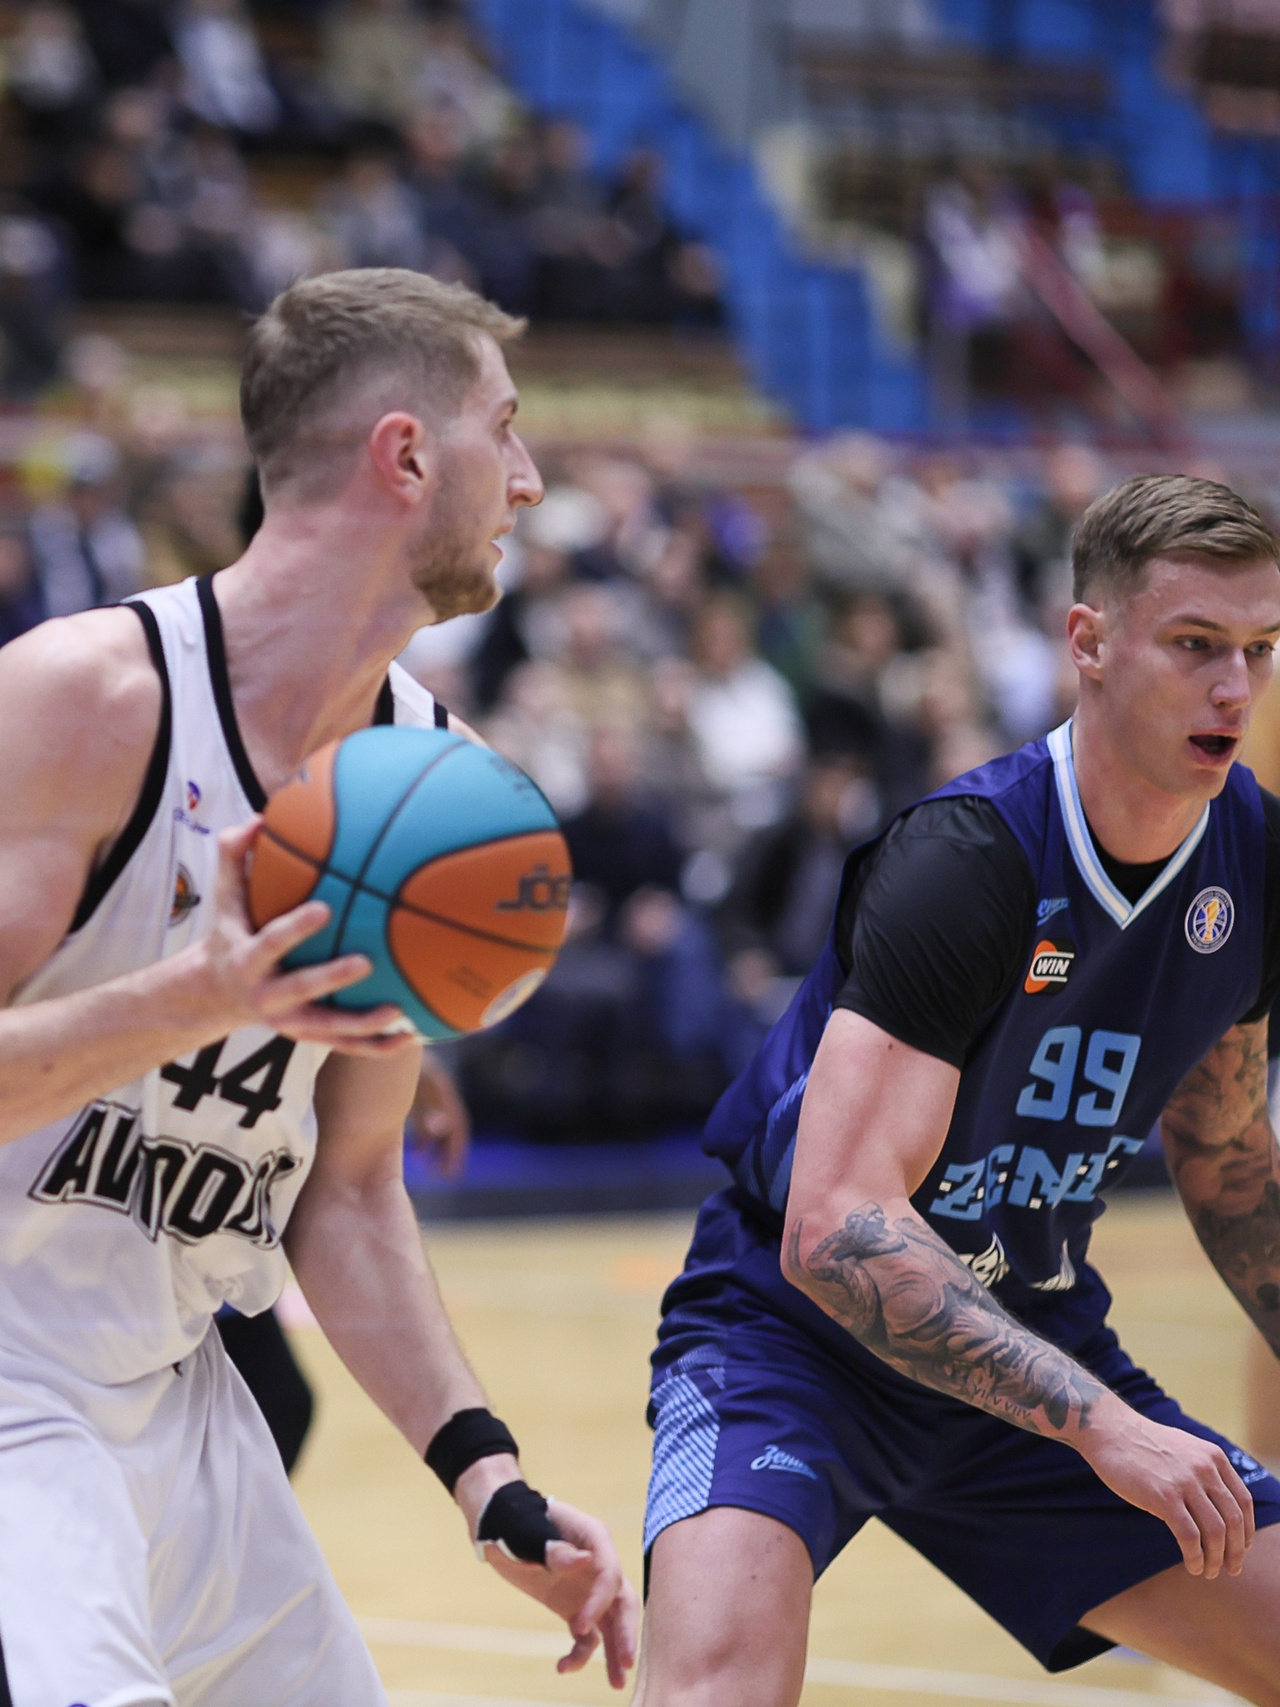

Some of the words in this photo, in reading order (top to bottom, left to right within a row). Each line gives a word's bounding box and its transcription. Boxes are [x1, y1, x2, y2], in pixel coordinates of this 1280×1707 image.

[1036, 957, 1069, 976] WIN
[160, 1034, 298, 1130] 44
[1015, 1024, 1141, 1127] 99
